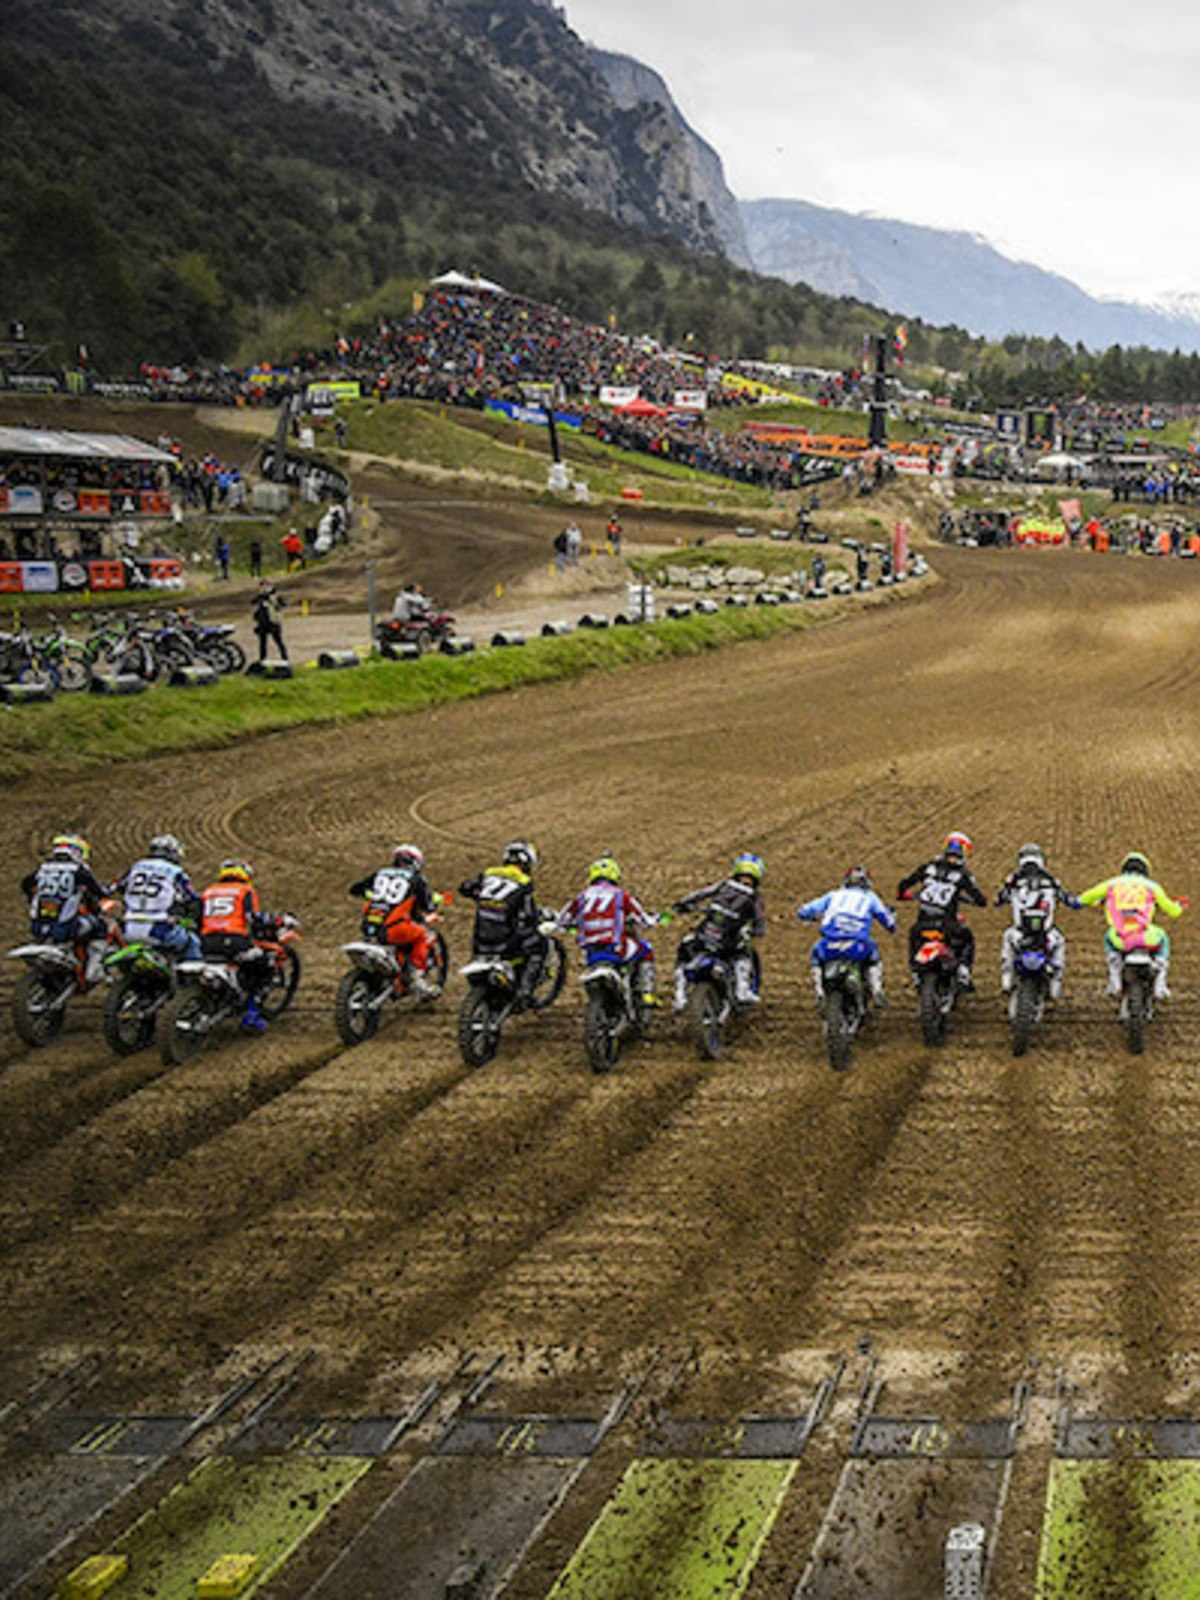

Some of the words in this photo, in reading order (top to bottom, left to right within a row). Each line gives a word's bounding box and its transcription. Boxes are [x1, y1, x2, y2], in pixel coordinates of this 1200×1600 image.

[128, 872, 166, 898] 25
[372, 875, 410, 904] 99
[480, 876, 519, 901] 27
[203, 896, 236, 917] 15
[583, 890, 614, 913] 77
